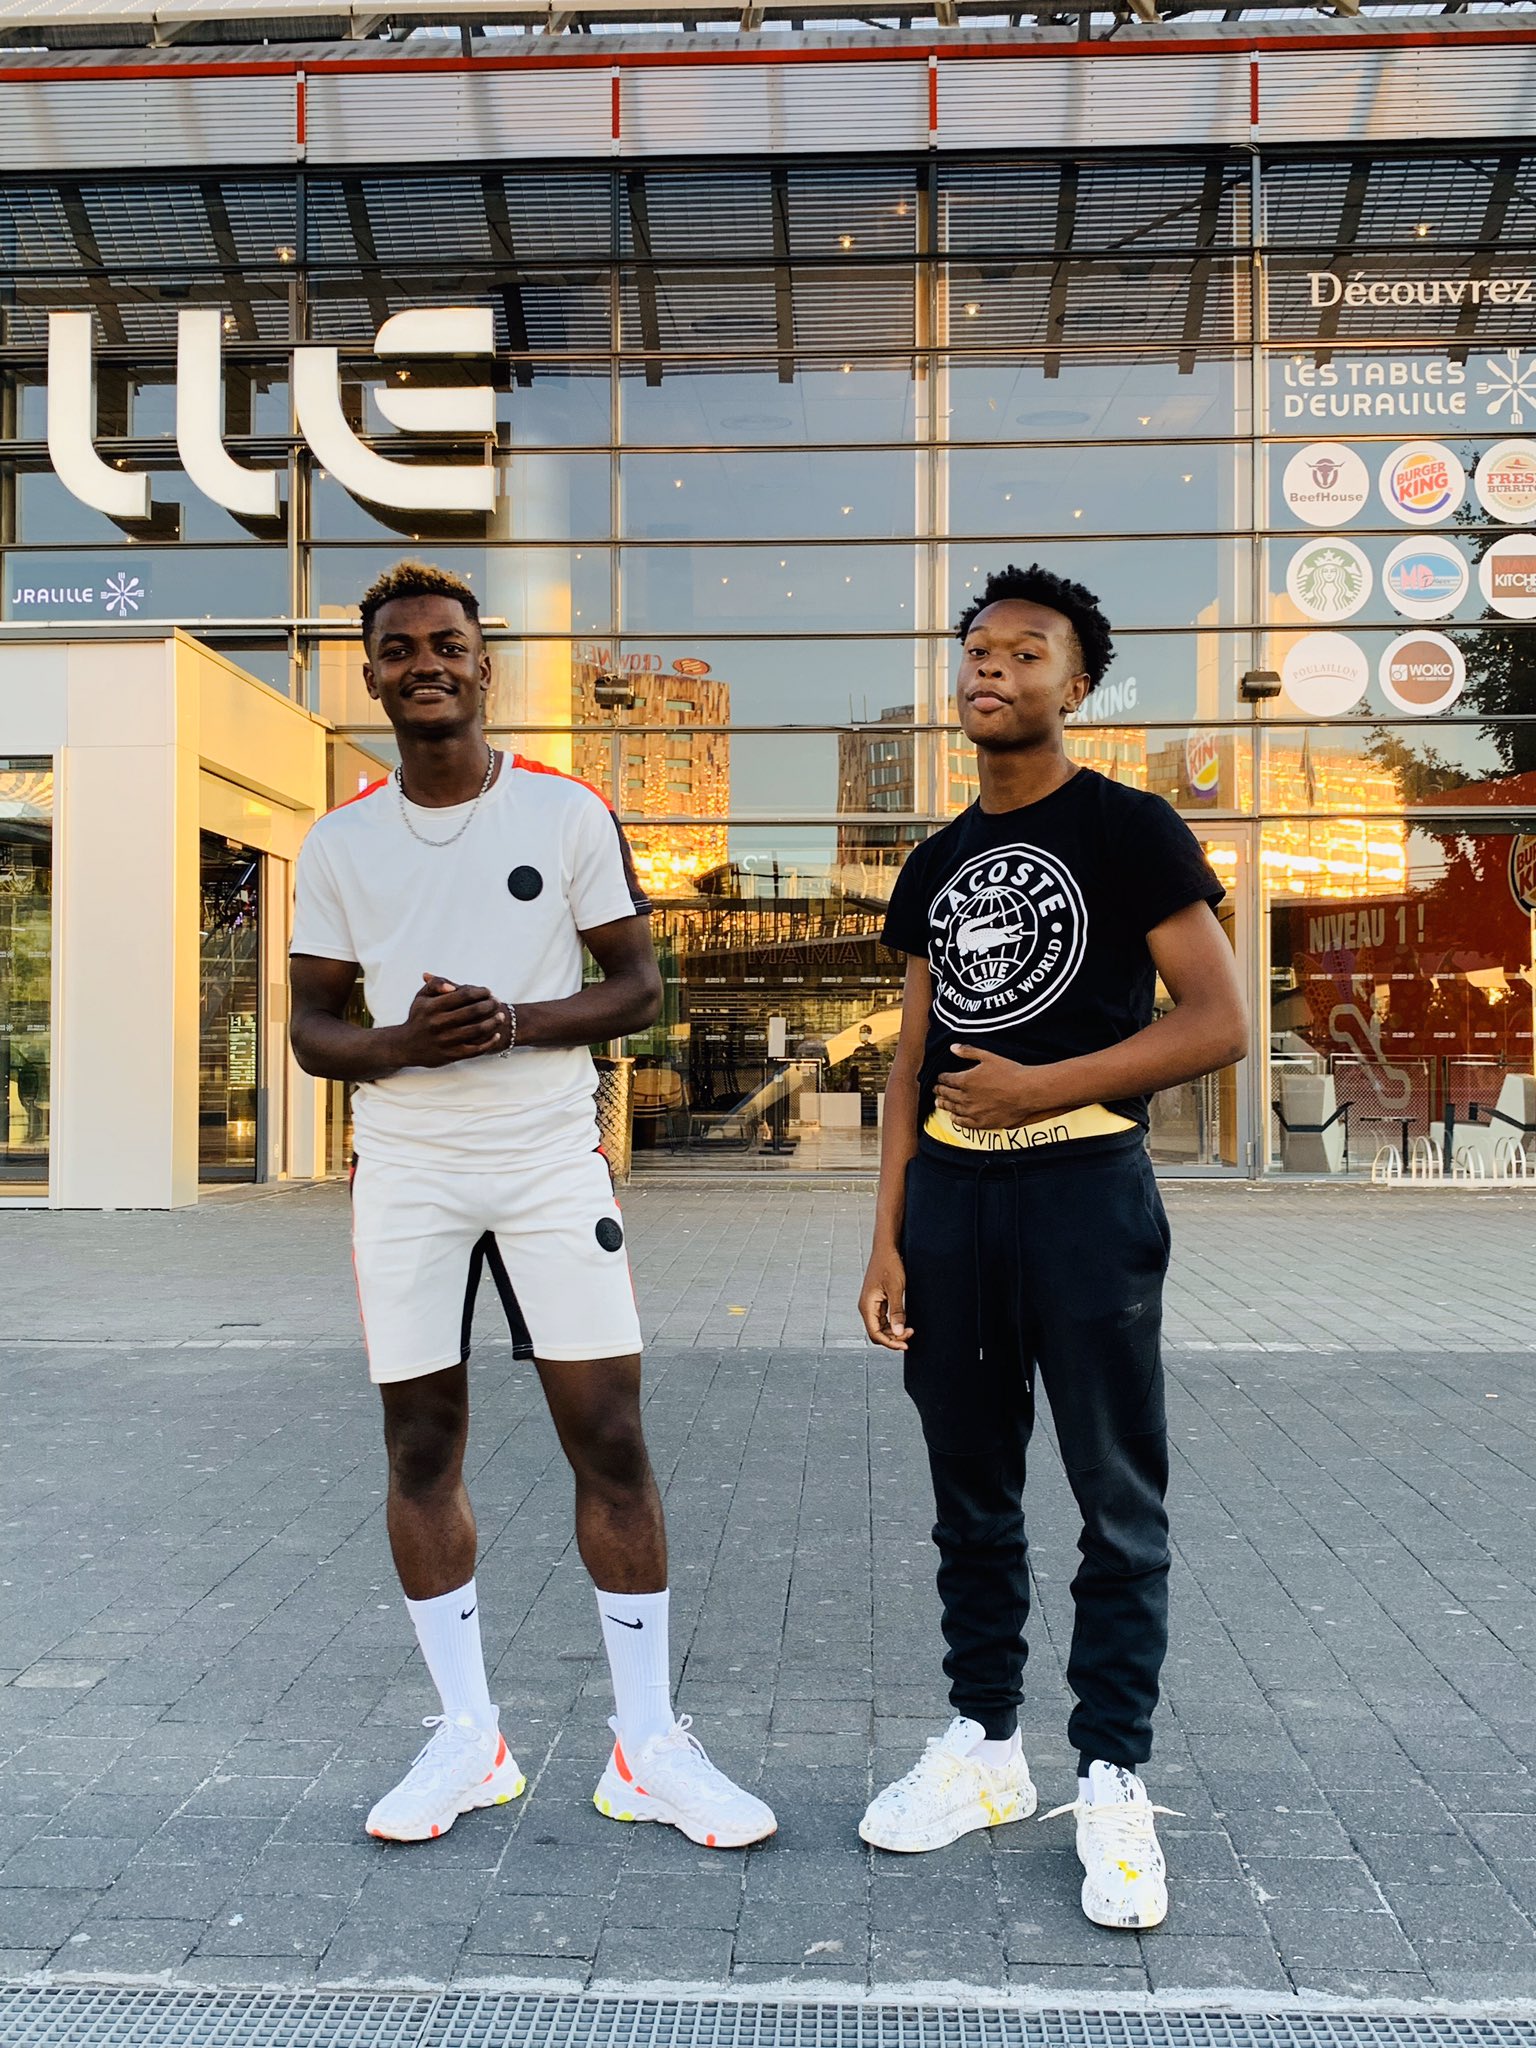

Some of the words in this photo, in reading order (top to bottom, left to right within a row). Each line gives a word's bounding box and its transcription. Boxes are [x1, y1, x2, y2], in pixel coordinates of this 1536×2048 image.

[1307, 271, 1533, 307] Découvrez
[1284, 362, 1338, 387] LES
[1346, 361, 1466, 386] TABLES
[1284, 391, 1466, 417] D'EURALILLE
[1396, 461, 1446, 486] BURGER
[1290, 491, 1363, 503] BeefHouse
[1399, 473, 1448, 503] KING
[1409, 663, 1453, 676] WOKO
[1092, 676, 1137, 722] KING
[931, 860, 1067, 930] LACOSTE
[1309, 907, 1385, 954] NIVEAU
[983, 988, 1018, 1010] THE
[1017, 938, 1063, 994] WORLD
[1006, 1124, 1070, 1151] Klein
